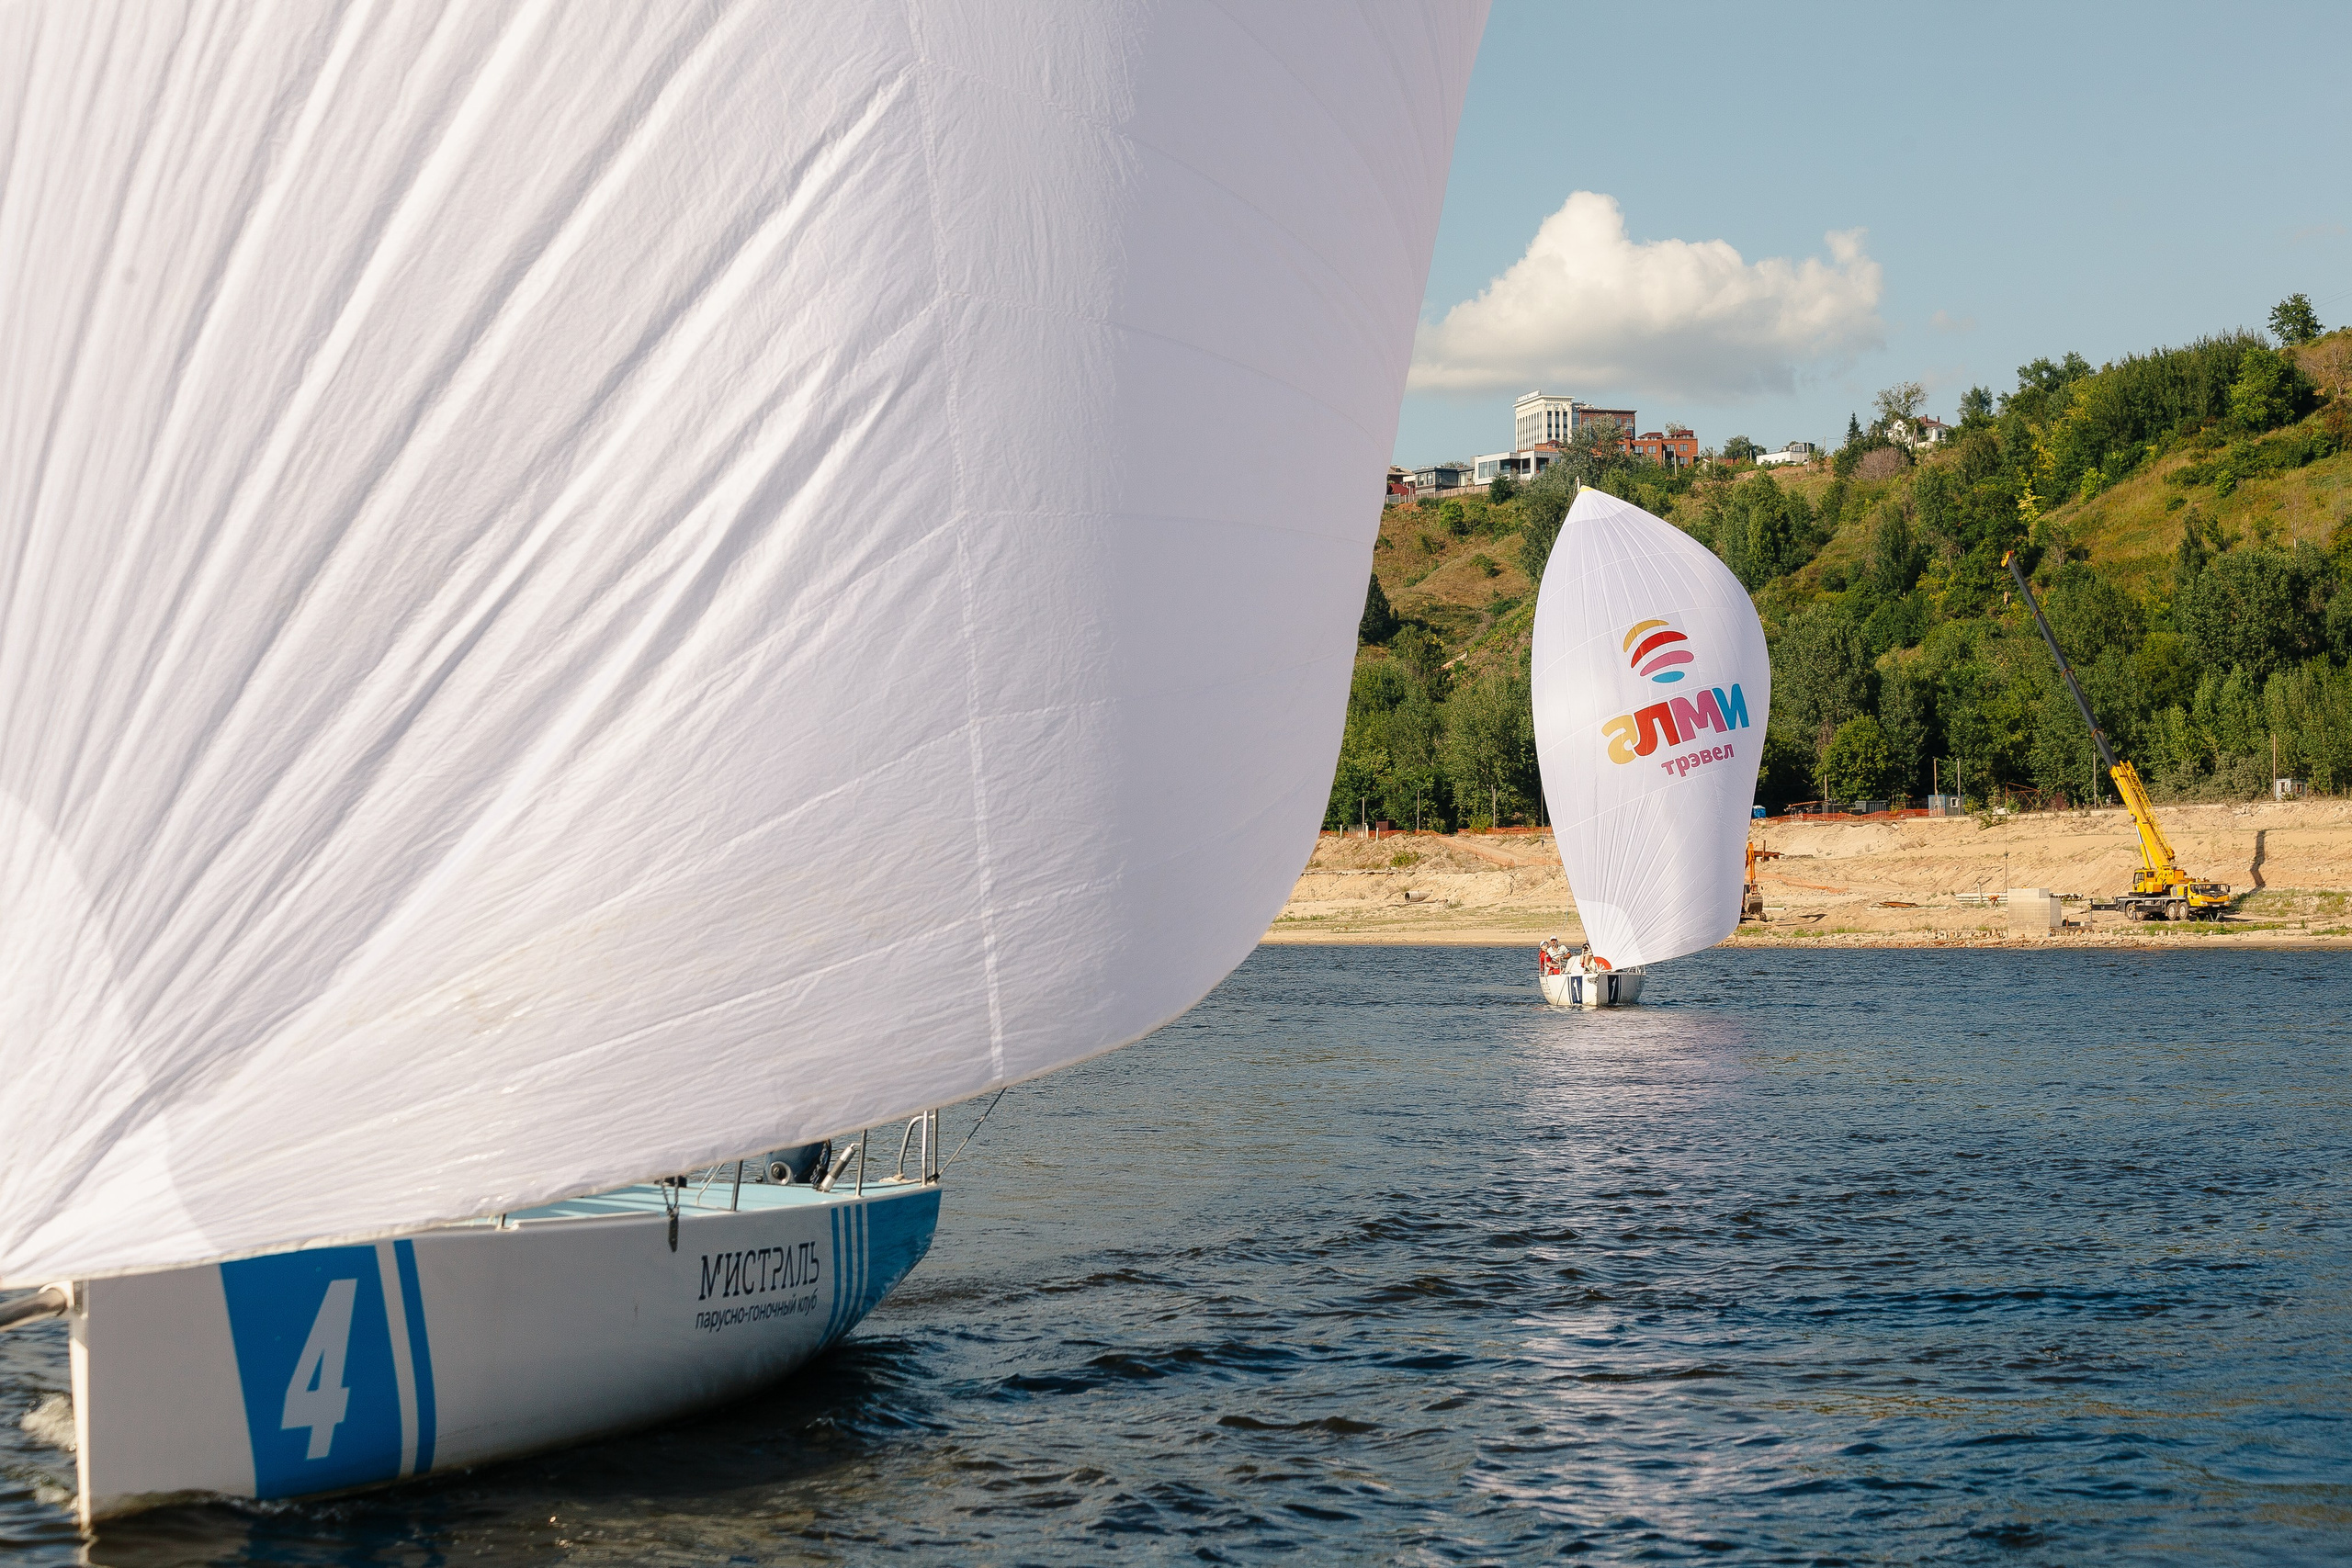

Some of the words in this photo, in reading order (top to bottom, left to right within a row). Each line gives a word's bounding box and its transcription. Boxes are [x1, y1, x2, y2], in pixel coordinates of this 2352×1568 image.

[1660, 743, 1735, 778] трэвел
[1573, 978, 1580, 1001] 1
[1611, 977, 1617, 1000] 1
[698, 1241, 820, 1301] МИСТРАЛЬ
[695, 1293, 797, 1333] парусно-гоночный
[797, 1287, 819, 1316] клуб
[280, 1278, 357, 1460] 4
